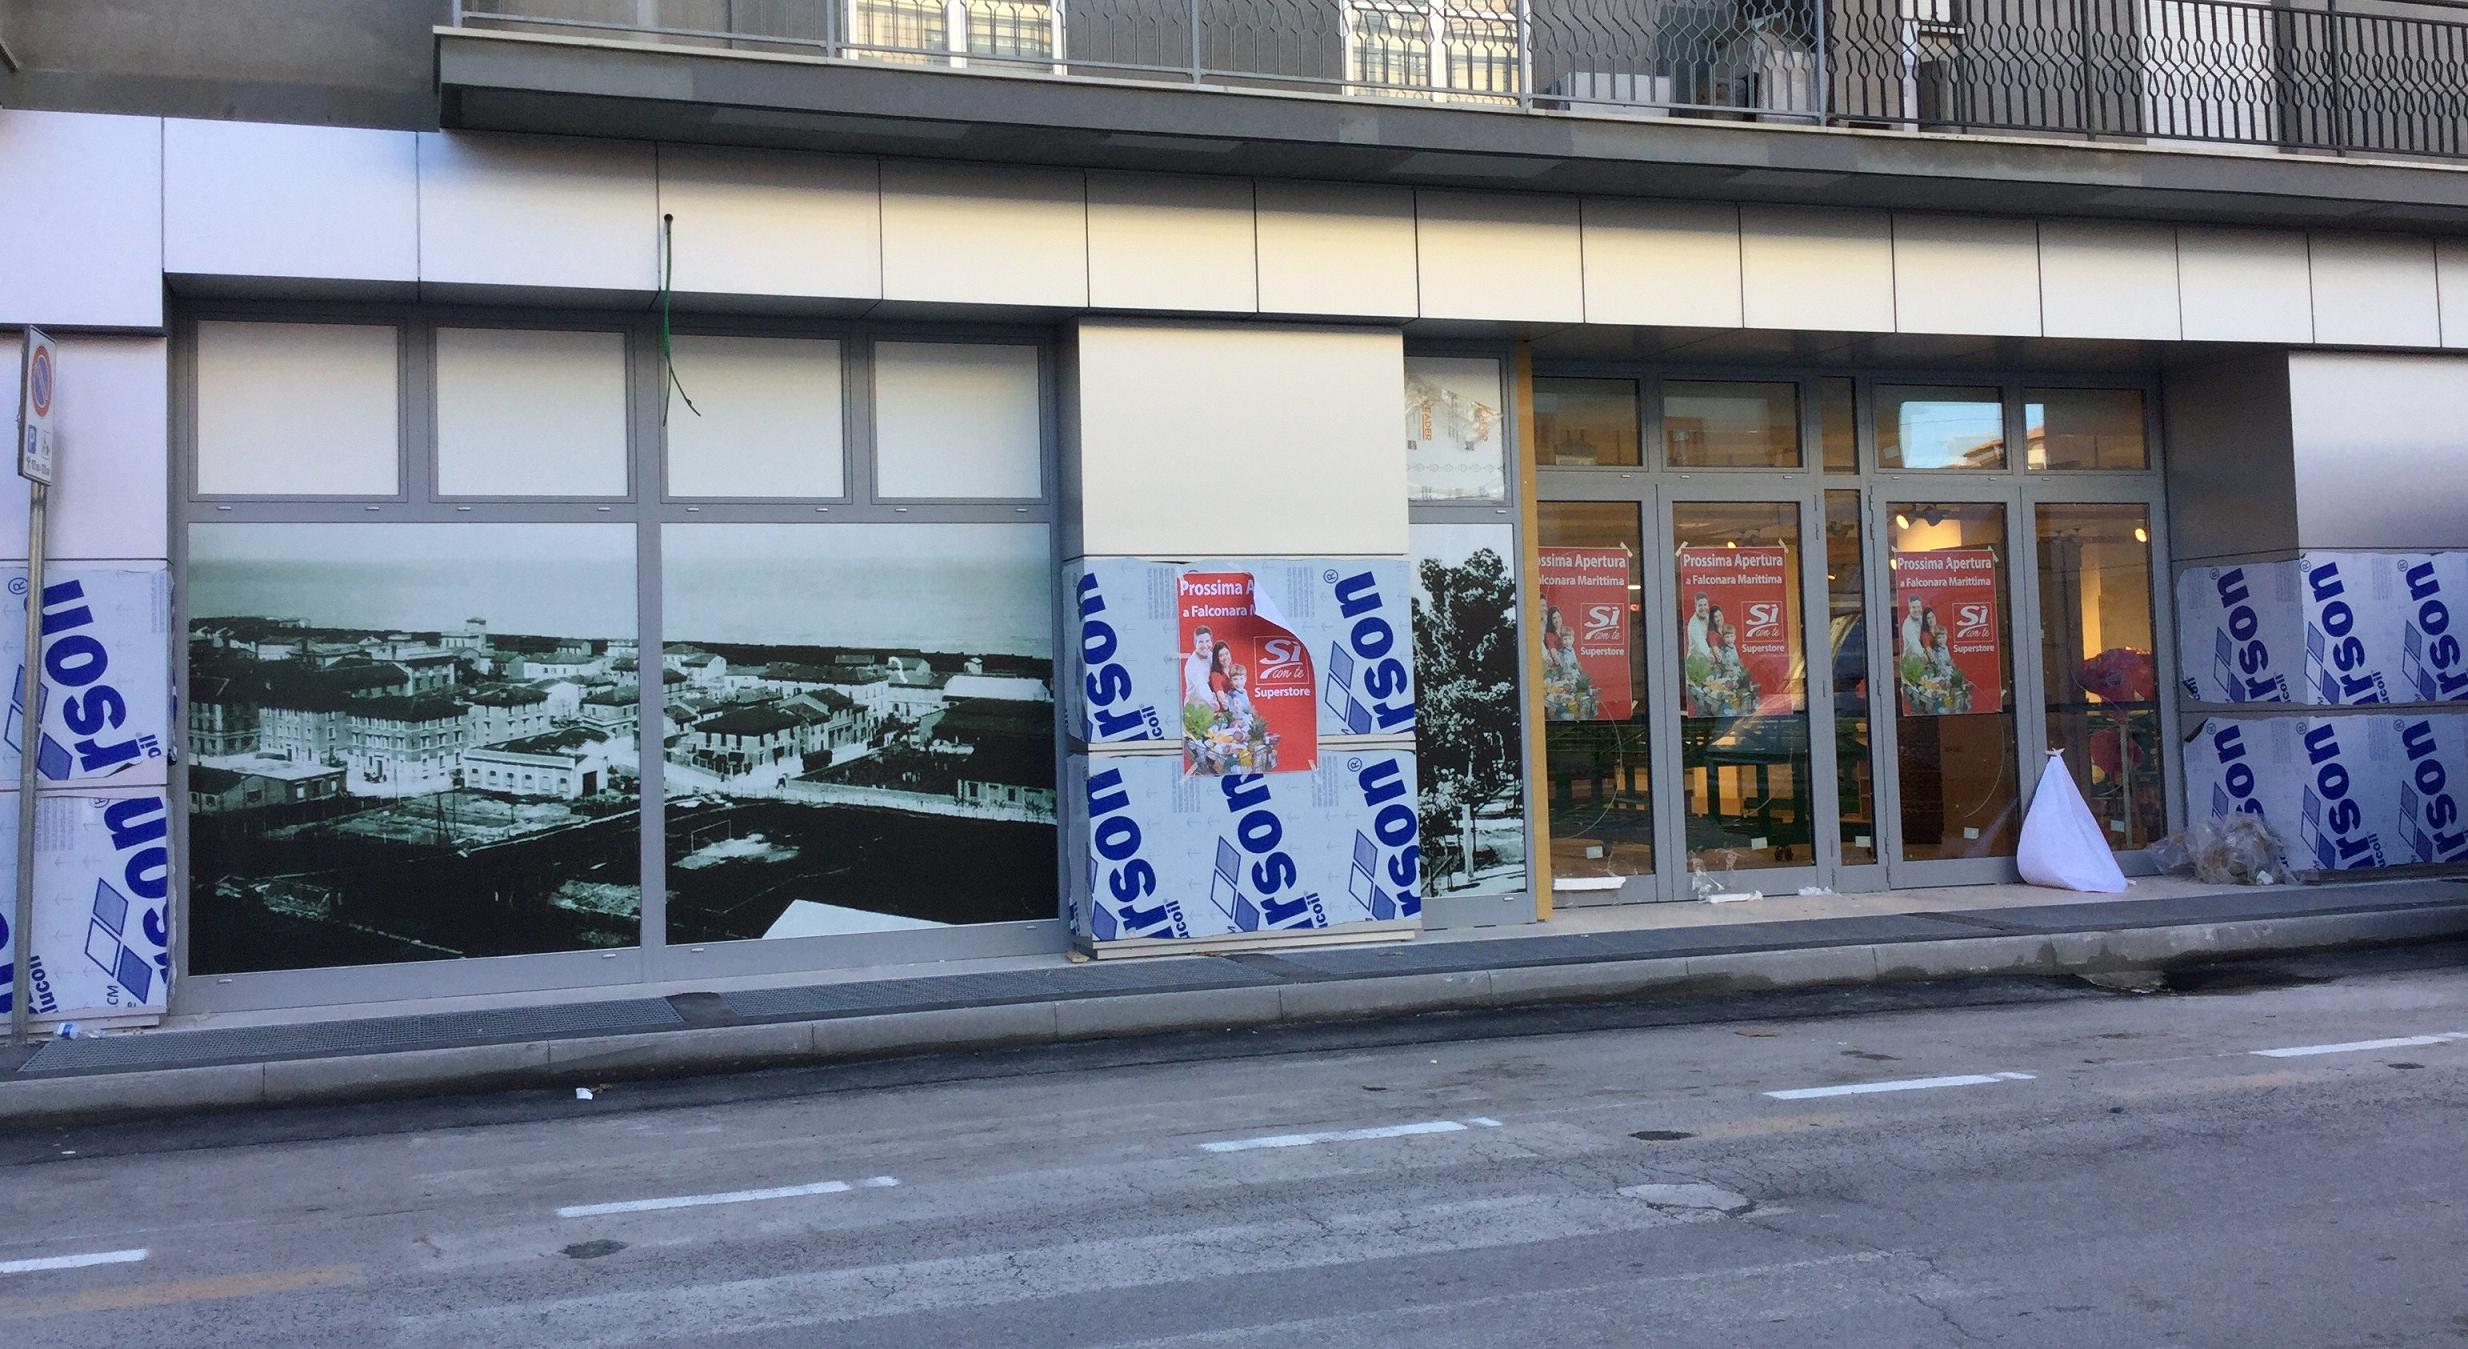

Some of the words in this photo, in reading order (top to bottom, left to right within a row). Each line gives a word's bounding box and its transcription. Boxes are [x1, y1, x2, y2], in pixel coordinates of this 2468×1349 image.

[1575, 553, 1626, 571] Apertura
[1683, 553, 1732, 567] Prossima
[1734, 553, 1783, 570] Apertura
[1897, 556, 1943, 570] Prossima
[1945, 556, 1992, 572] Apertura
[1577, 575, 1625, 586] Marittima
[1692, 574, 1736, 585] Falconara
[1737, 573, 1782, 584] Marittima
[1906, 577, 1948, 587] Falconara
[1949, 576, 1991, 586] Marittima
[1180, 579, 1242, 596] Prossima
[1183, 609, 1190, 617] a
[1191, 605, 1248, 617] Falconara
[2217, 568, 2281, 701] rson
[2406, 562, 2468, 700] rson
[1076, 572, 1146, 740] rson
[1334, 572, 1415, 735] rson
[1580, 646, 1624, 657] Superstore
[1742, 643, 1785, 654] Superstore
[1953, 644, 1994, 655] Superstore
[1272, 667, 1292, 679] con
[1293, 665, 1304, 679] te
[1255, 687, 1311, 699] Superstore
[2275, 674, 2291, 702] coil
[1142, 705, 1163, 740] coil
[2402, 721, 2468, 866] rson
